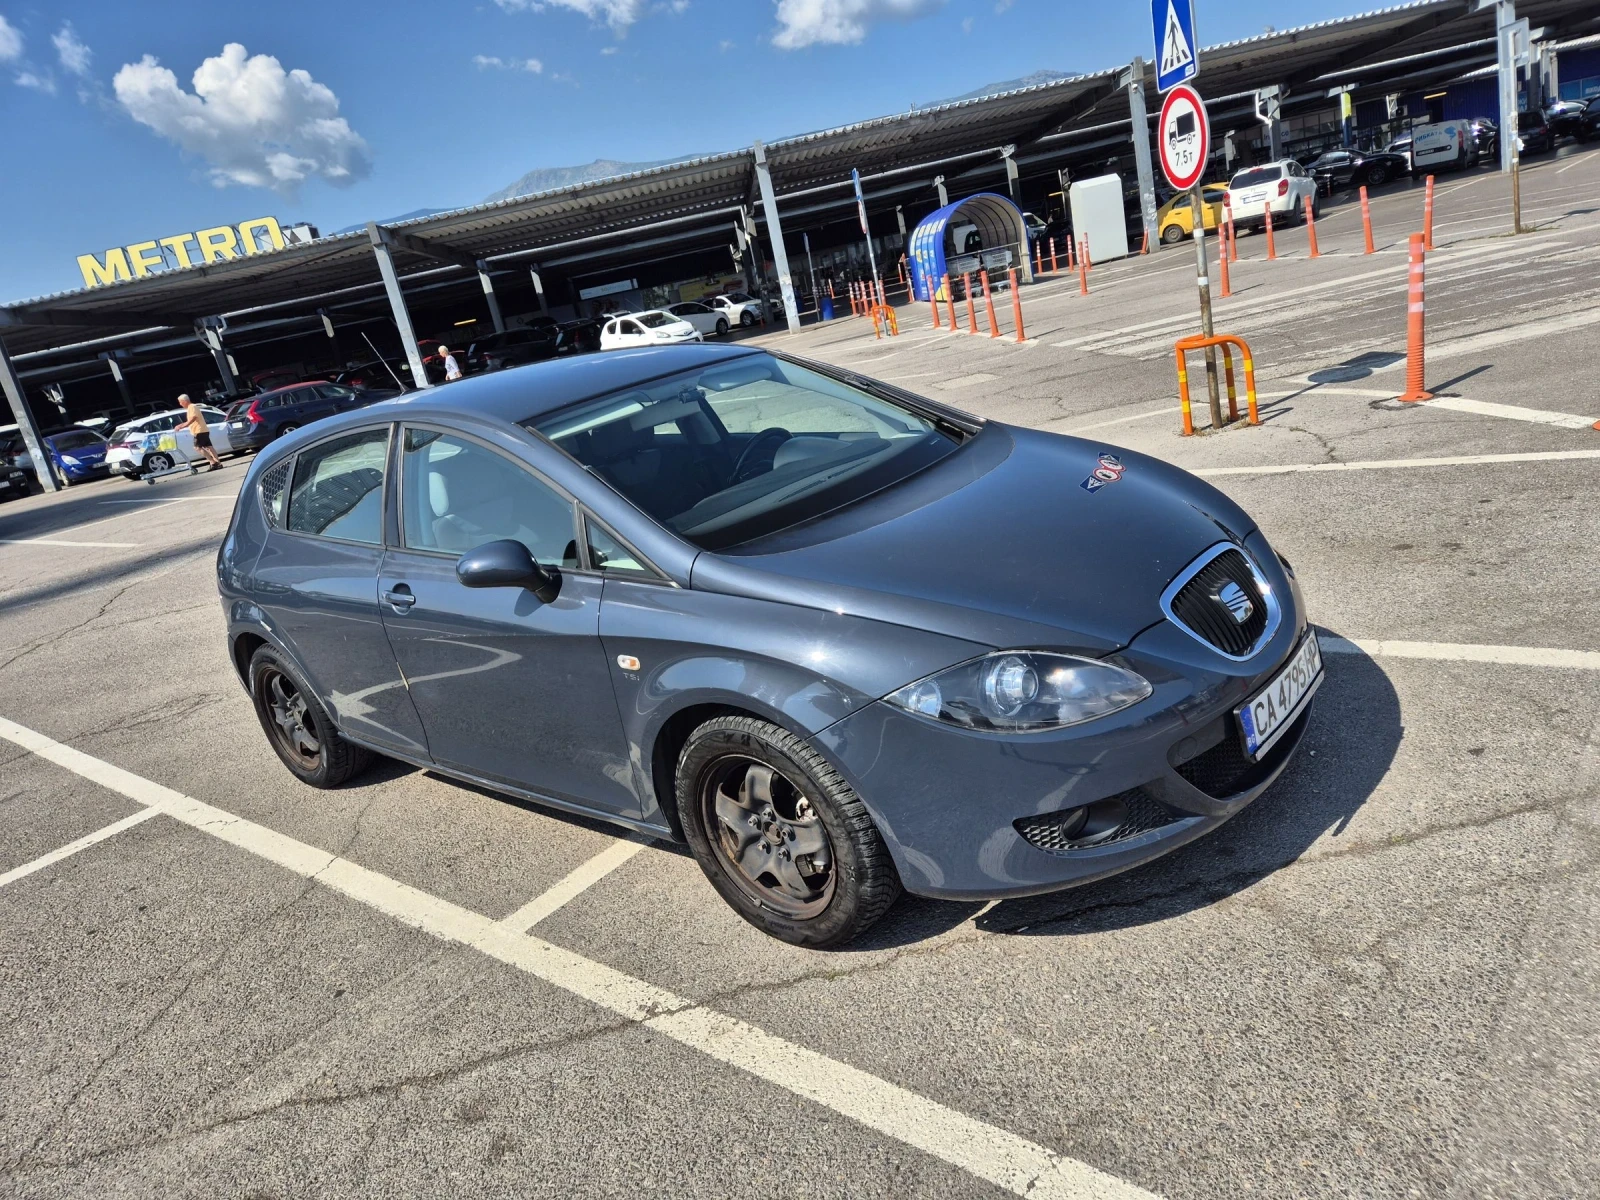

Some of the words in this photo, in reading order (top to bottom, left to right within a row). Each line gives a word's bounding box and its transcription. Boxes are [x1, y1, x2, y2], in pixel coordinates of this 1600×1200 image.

[76, 215, 285, 289] METRO
[1254, 692, 1278, 737] CA
[1278, 656, 1307, 712] 4795
[1303, 637, 1317, 680] HP
